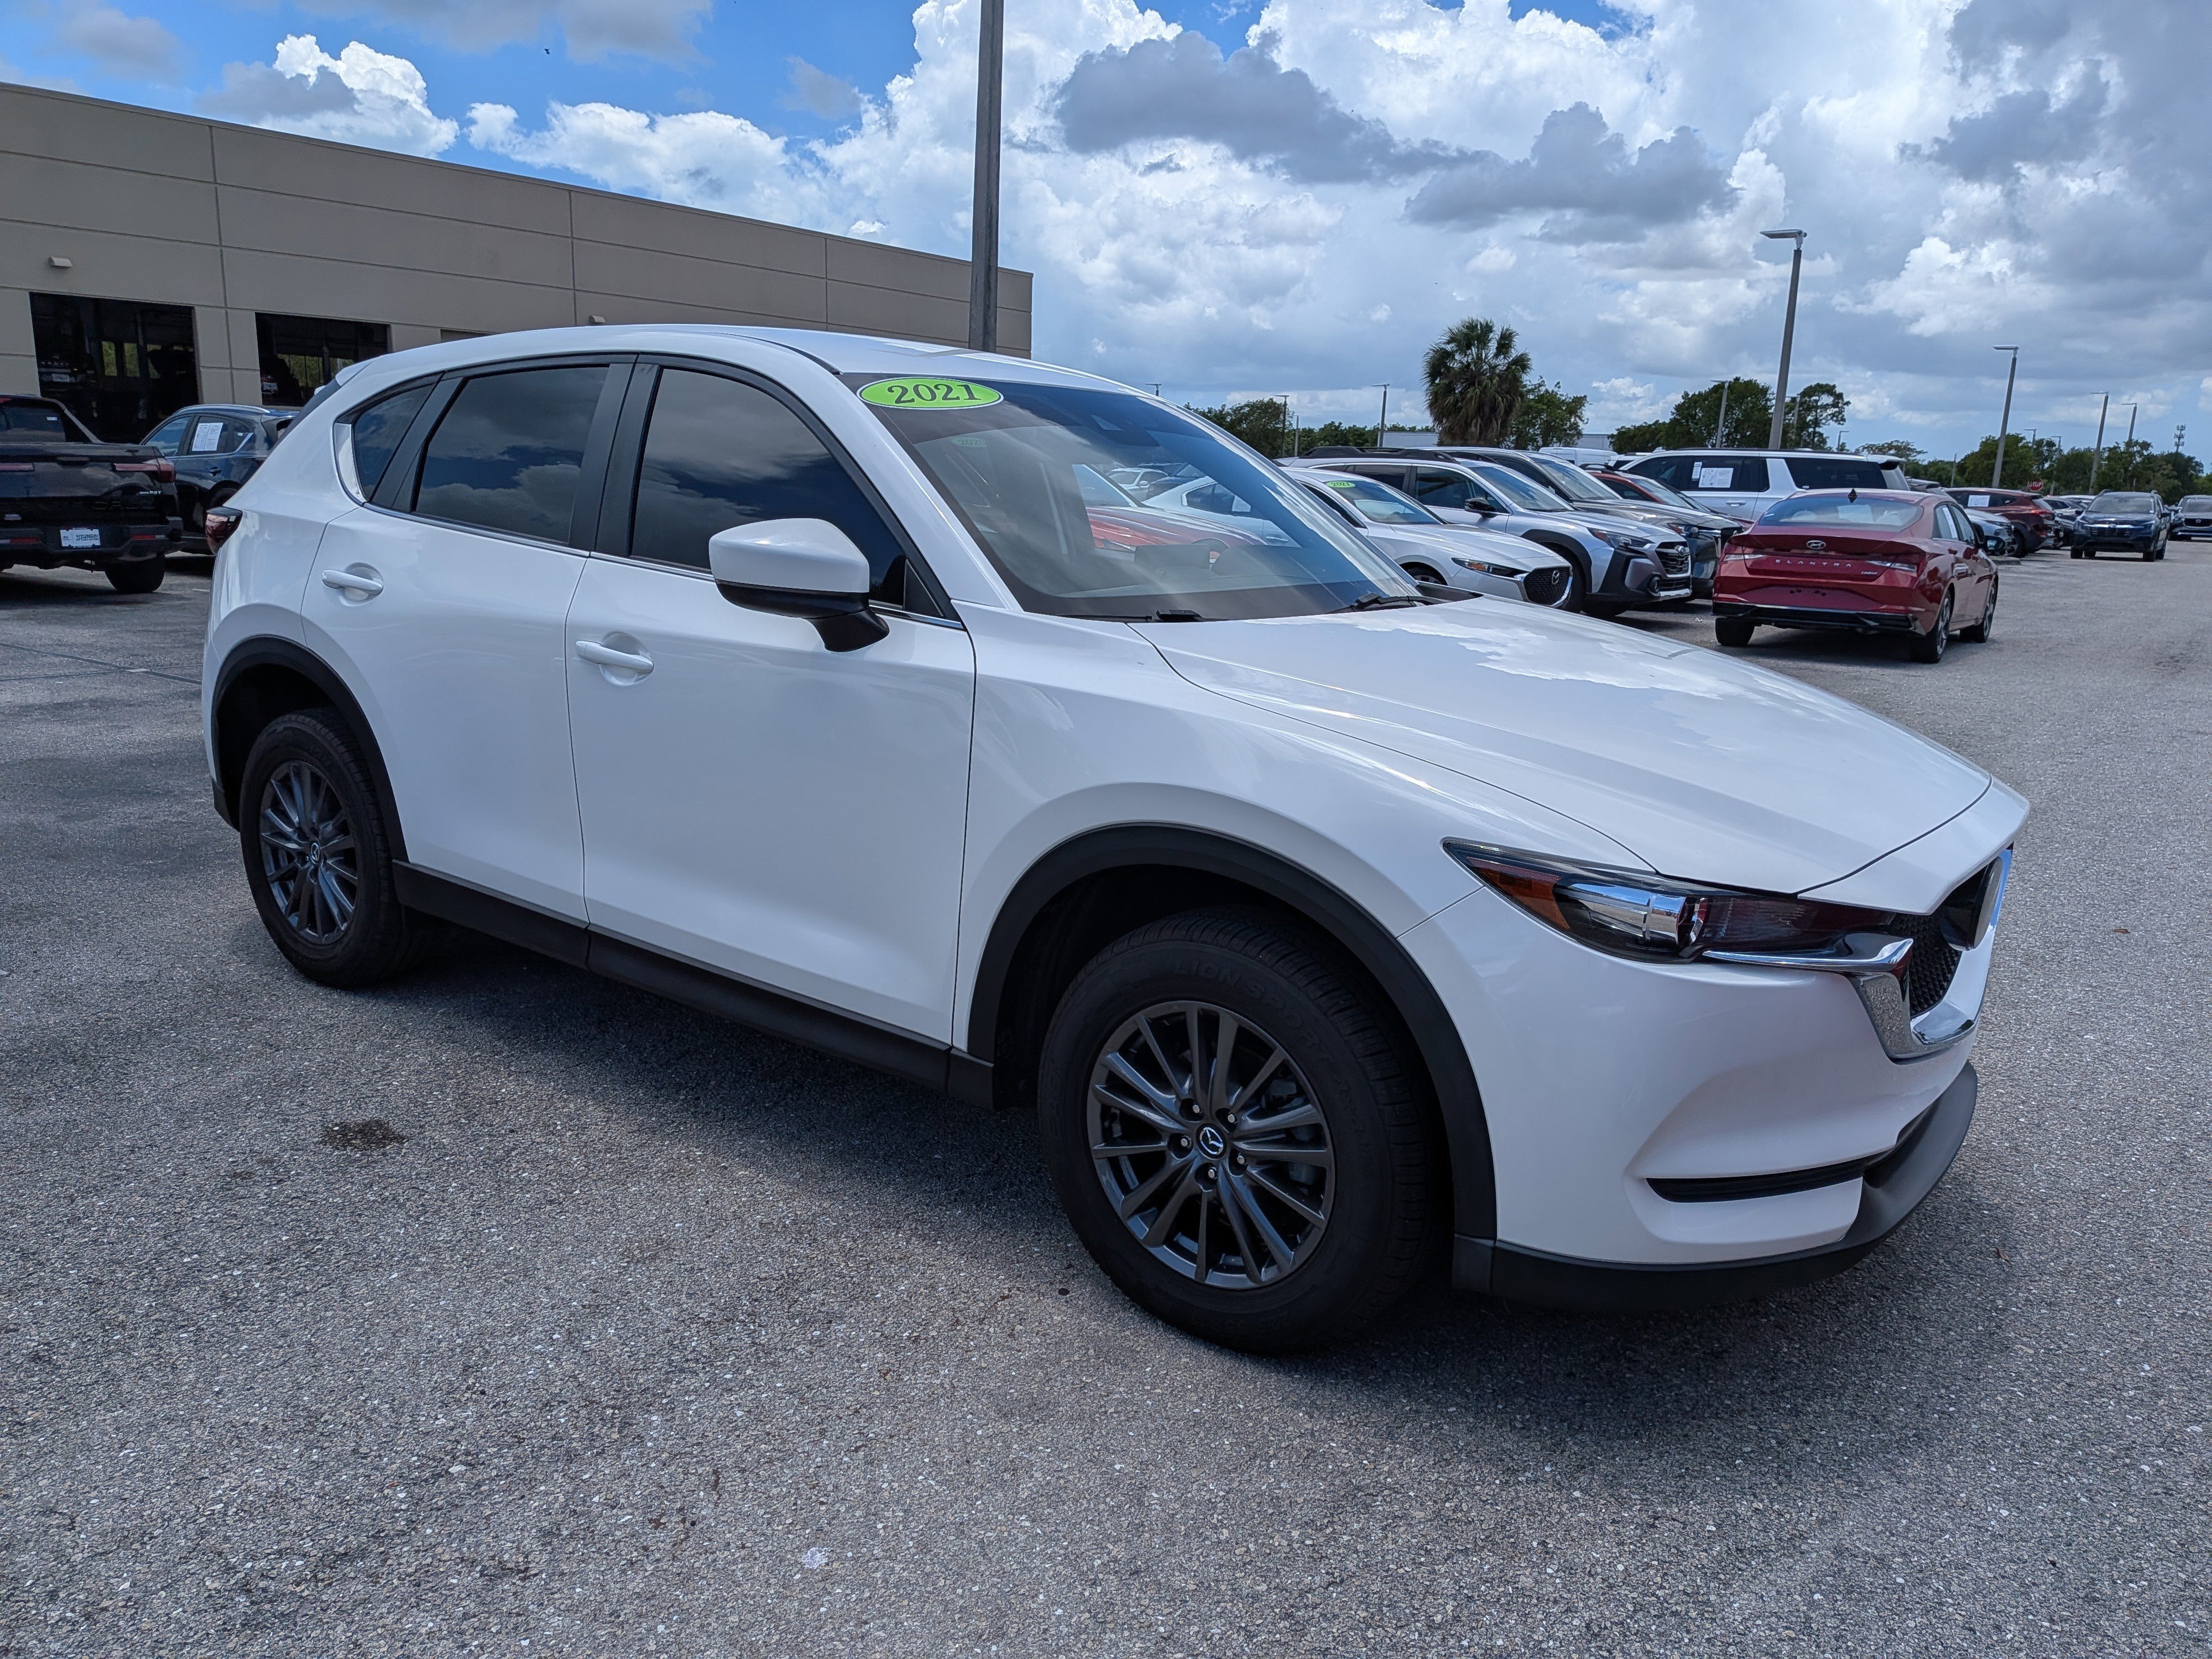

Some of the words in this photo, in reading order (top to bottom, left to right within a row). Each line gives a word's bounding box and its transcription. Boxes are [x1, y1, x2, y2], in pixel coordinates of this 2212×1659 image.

[887, 384, 982, 404] 2021
[1775, 559, 1851, 567] ELANTRA
[1173, 959, 1241, 985] LION
[1244, 977, 1336, 1068] SPORT
